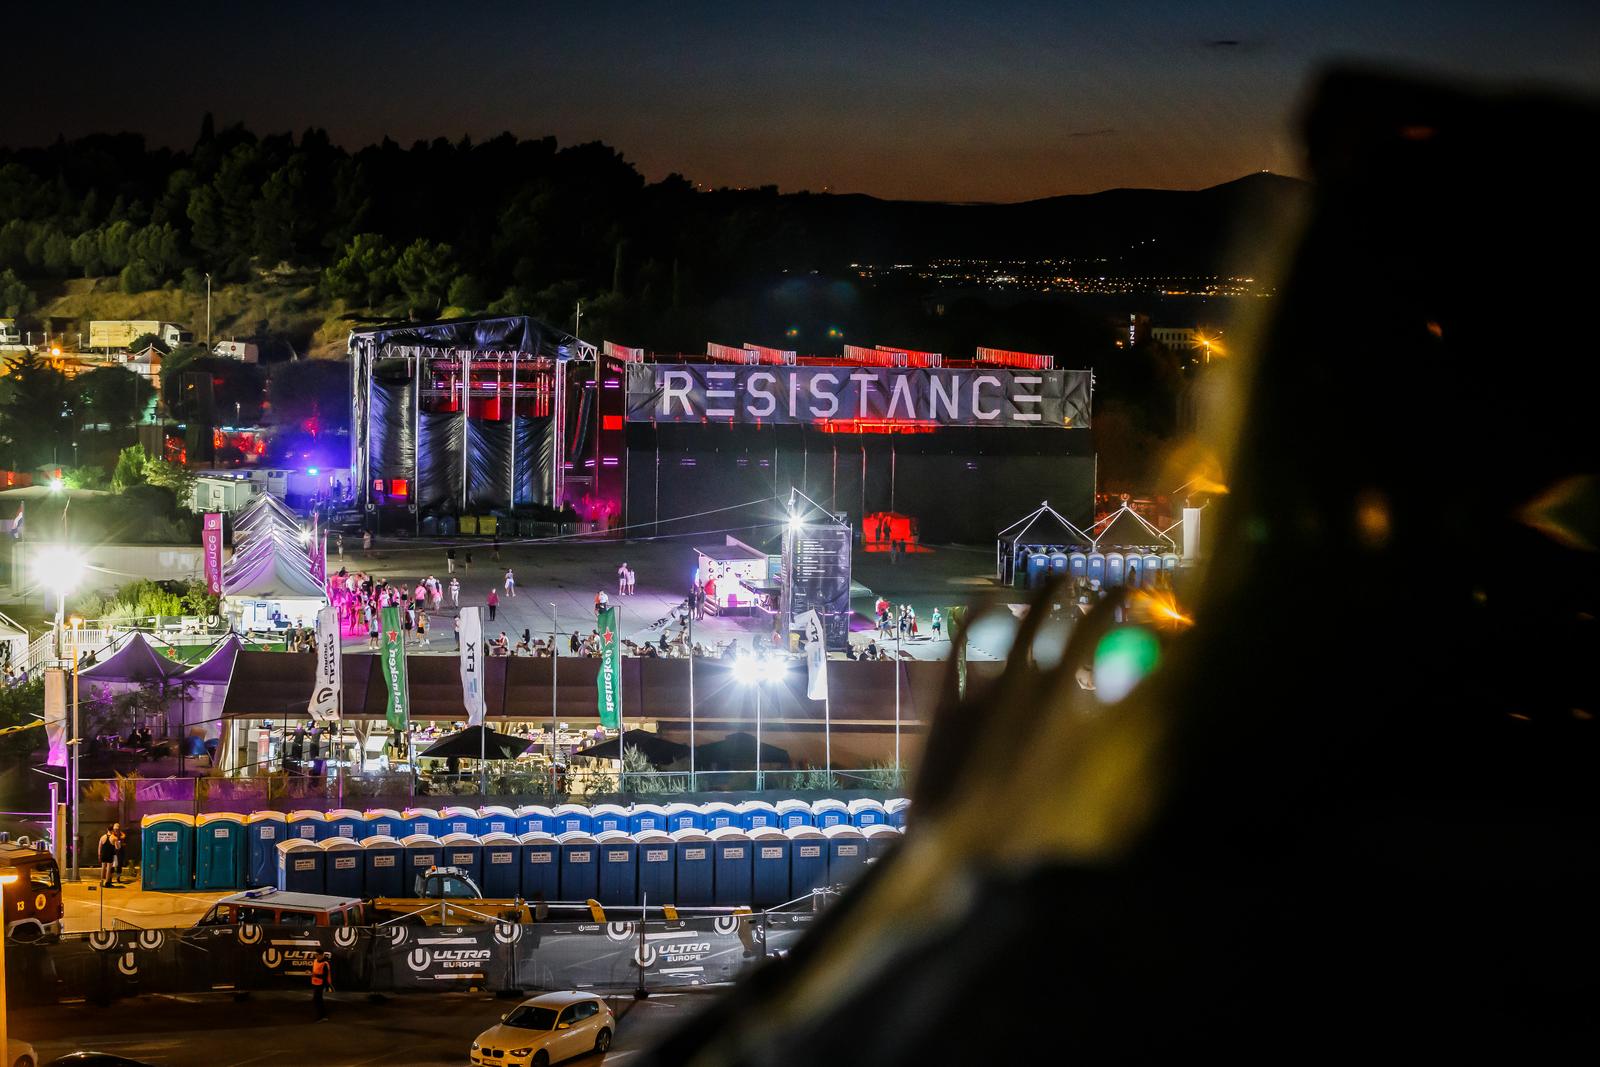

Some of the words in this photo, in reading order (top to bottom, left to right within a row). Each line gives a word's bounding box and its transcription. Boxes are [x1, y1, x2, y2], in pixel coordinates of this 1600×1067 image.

[663, 371, 1042, 421] RESISTANCE
[16, 901, 25, 911] 13
[658, 942, 711, 955] ULTRA
[433, 949, 491, 960] ULTRA
[666, 954, 701, 962] EUROPE
